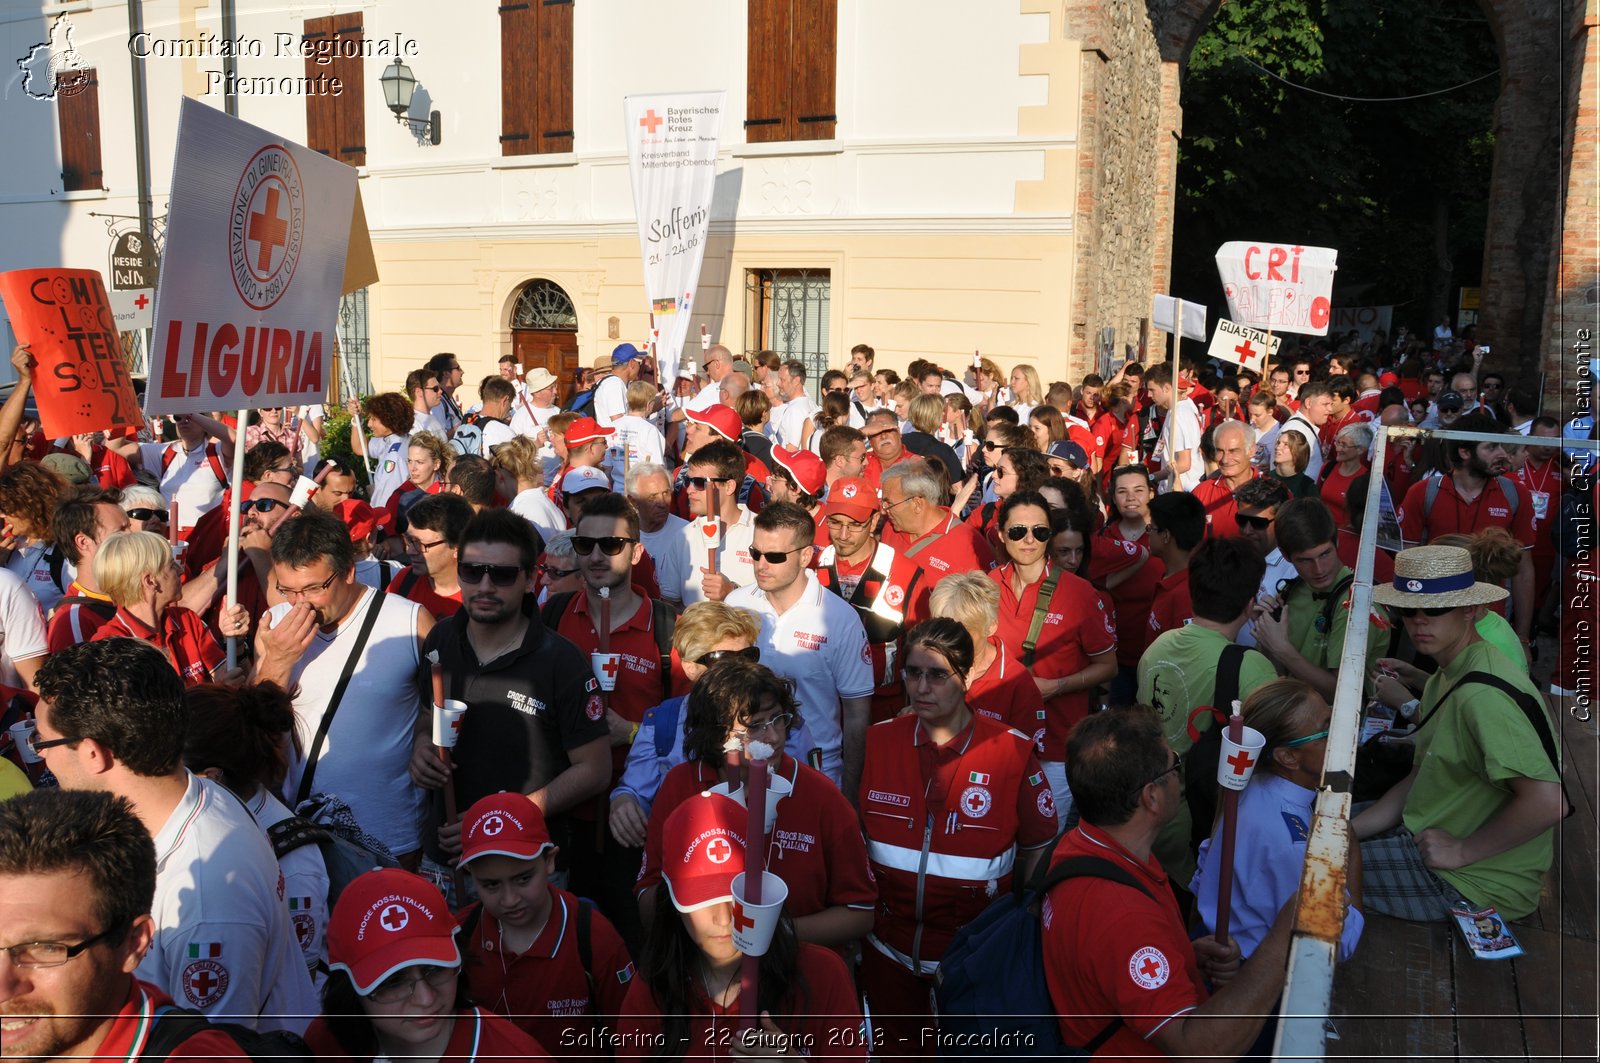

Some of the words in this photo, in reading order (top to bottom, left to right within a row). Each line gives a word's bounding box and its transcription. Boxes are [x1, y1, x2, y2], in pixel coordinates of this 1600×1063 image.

[667, 107, 720, 116] Bayerisches
[667, 116, 693, 124] Rotes
[668, 125, 694, 133] Kreuz
[641, 150, 690, 160] Kreisverband
[258, 153, 292, 183] GINEVRA
[247, 167, 258, 190] DI
[289, 180, 300, 201] 22
[233, 187, 256, 301] CONVENZIONE
[284, 206, 302, 275] AGOSTO
[31, 276, 102, 305] COMI
[264, 276, 285, 303] 1864
[1224, 282, 1330, 329] PALERMO
[59, 306, 114, 332] LOC
[1334, 307, 1377, 326] INO
[1220, 321, 1278, 349] GUASTALA
[161, 320, 323, 398] LIGURIA
[793, 630, 810, 641] CROCE
[810, 634, 828, 644] ROSSA
[797, 640, 820, 651] ITALIANA
[621, 653, 638, 664] CROCE
[638, 657, 656, 670] ROSSA
[625, 661, 648, 674] ITALIANA
[507, 690, 526, 703] CROCE
[527, 697, 546, 710] ROSSA
[511, 701, 537, 716] ITALIANA
[870, 792, 901, 804] SQUADRA
[482, 810, 502, 819] ROSSA
[502, 811, 524, 831] ITALIANA
[684, 837, 701, 863] CROCE
[700, 828, 726, 840] ROSSA
[776, 830, 798, 841] CROCE
[780, 840, 809, 852] ITALIANA
[357, 909, 374, 941] CROCE
[371, 895, 400, 911] ROSSA
[402, 896, 434, 920] ITALIANA
